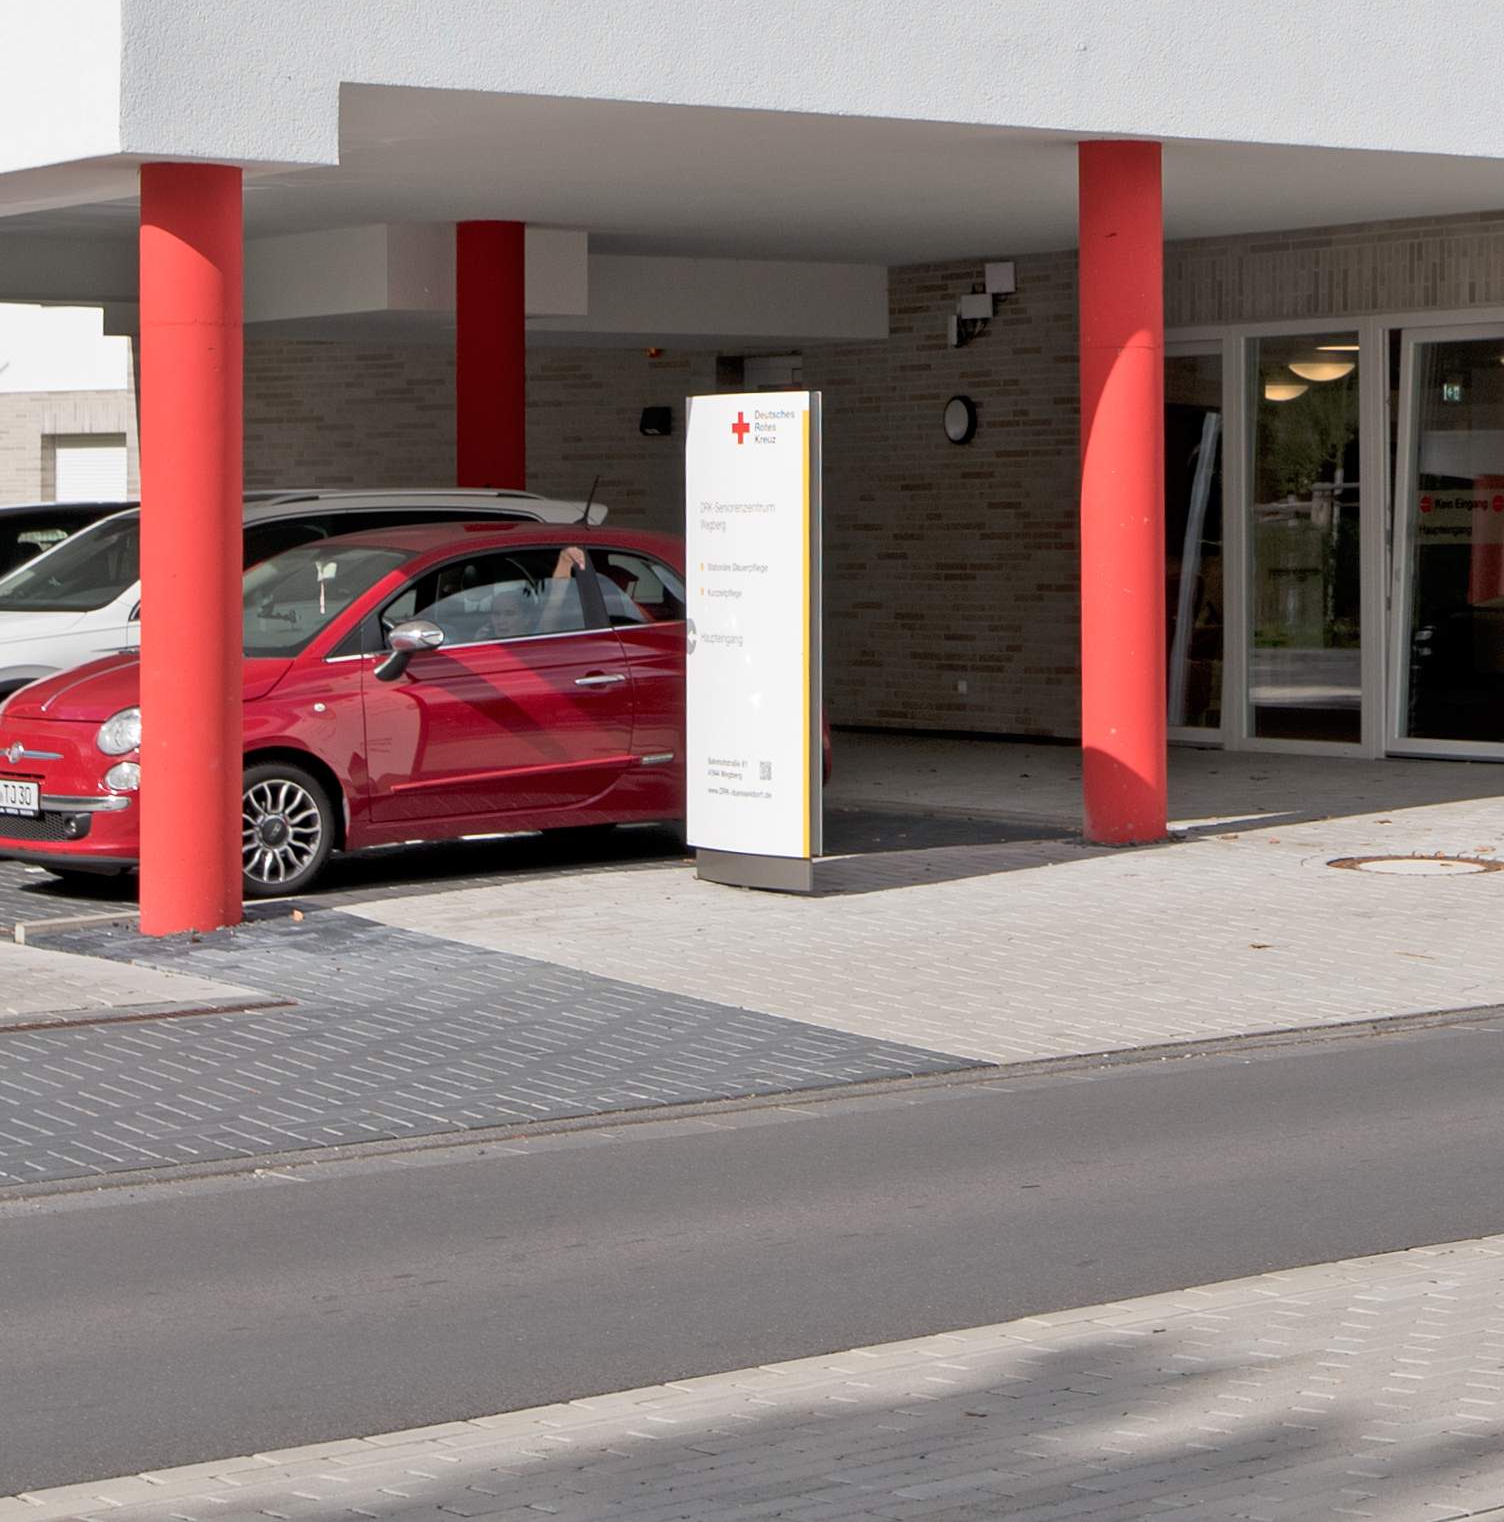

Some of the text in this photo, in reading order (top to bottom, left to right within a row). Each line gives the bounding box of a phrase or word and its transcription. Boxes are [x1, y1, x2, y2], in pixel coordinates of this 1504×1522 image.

[754, 410, 795, 420] Deutsches
[754, 422, 777, 432] Rotes
[754, 435, 777, 444] Kreuz
[1455, 498, 1488, 511] Eingang
